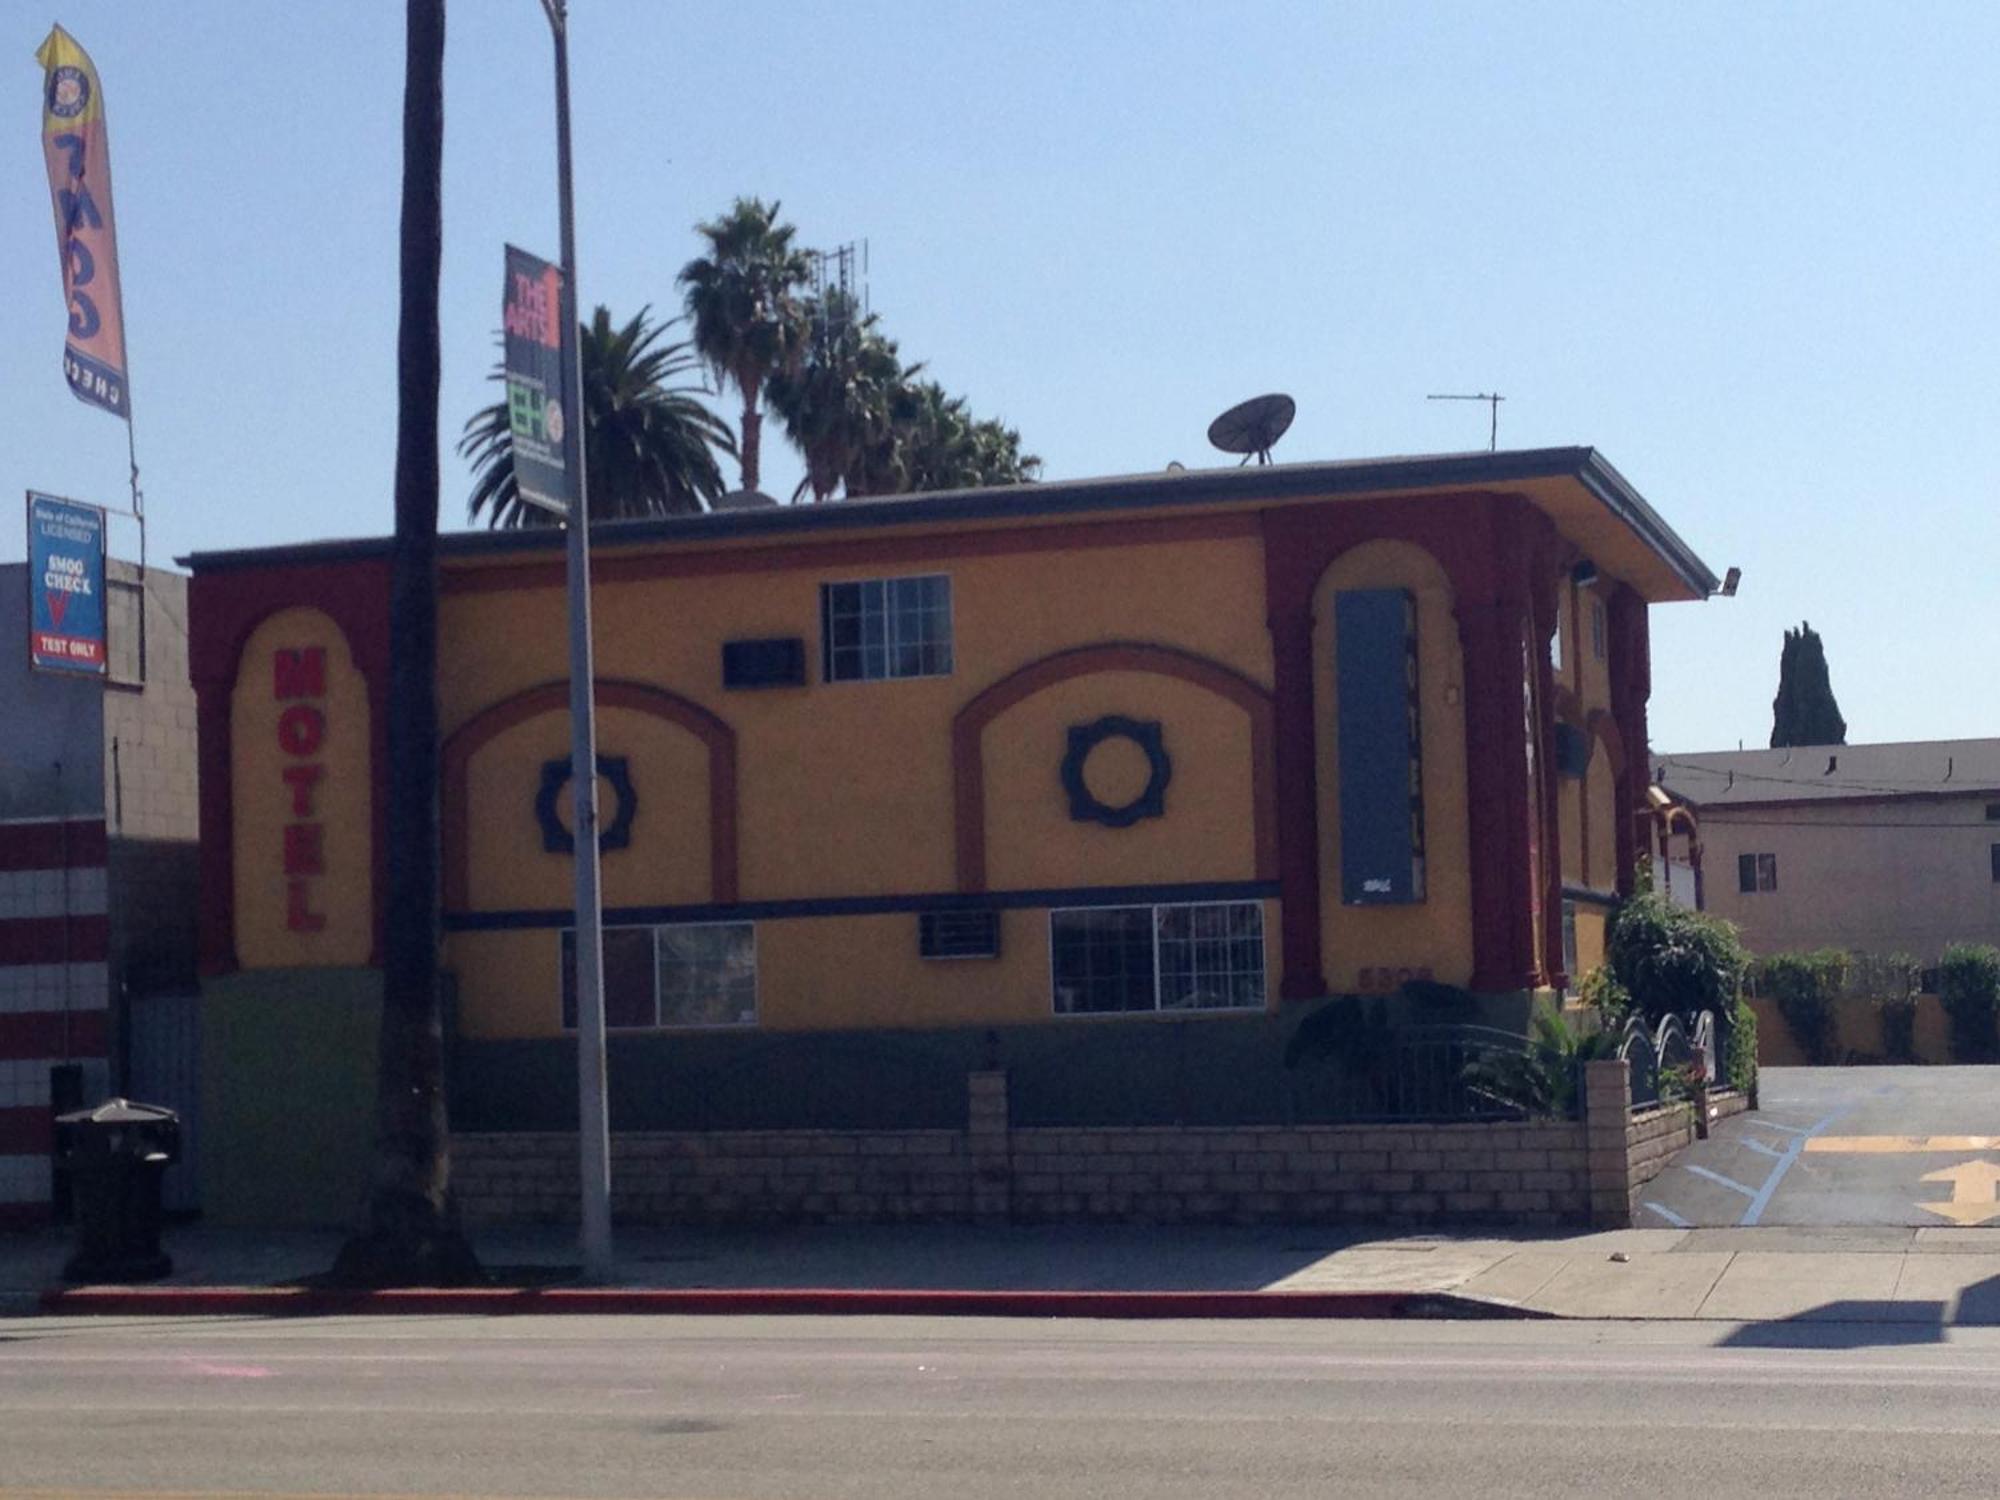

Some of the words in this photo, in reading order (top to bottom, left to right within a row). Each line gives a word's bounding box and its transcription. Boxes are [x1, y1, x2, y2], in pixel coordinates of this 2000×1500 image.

[44, 572, 92, 595] CHECK
[41, 636, 67, 655] TEST
[69, 639, 96, 657] ONLY
[274, 645, 327, 932] MOTEL
